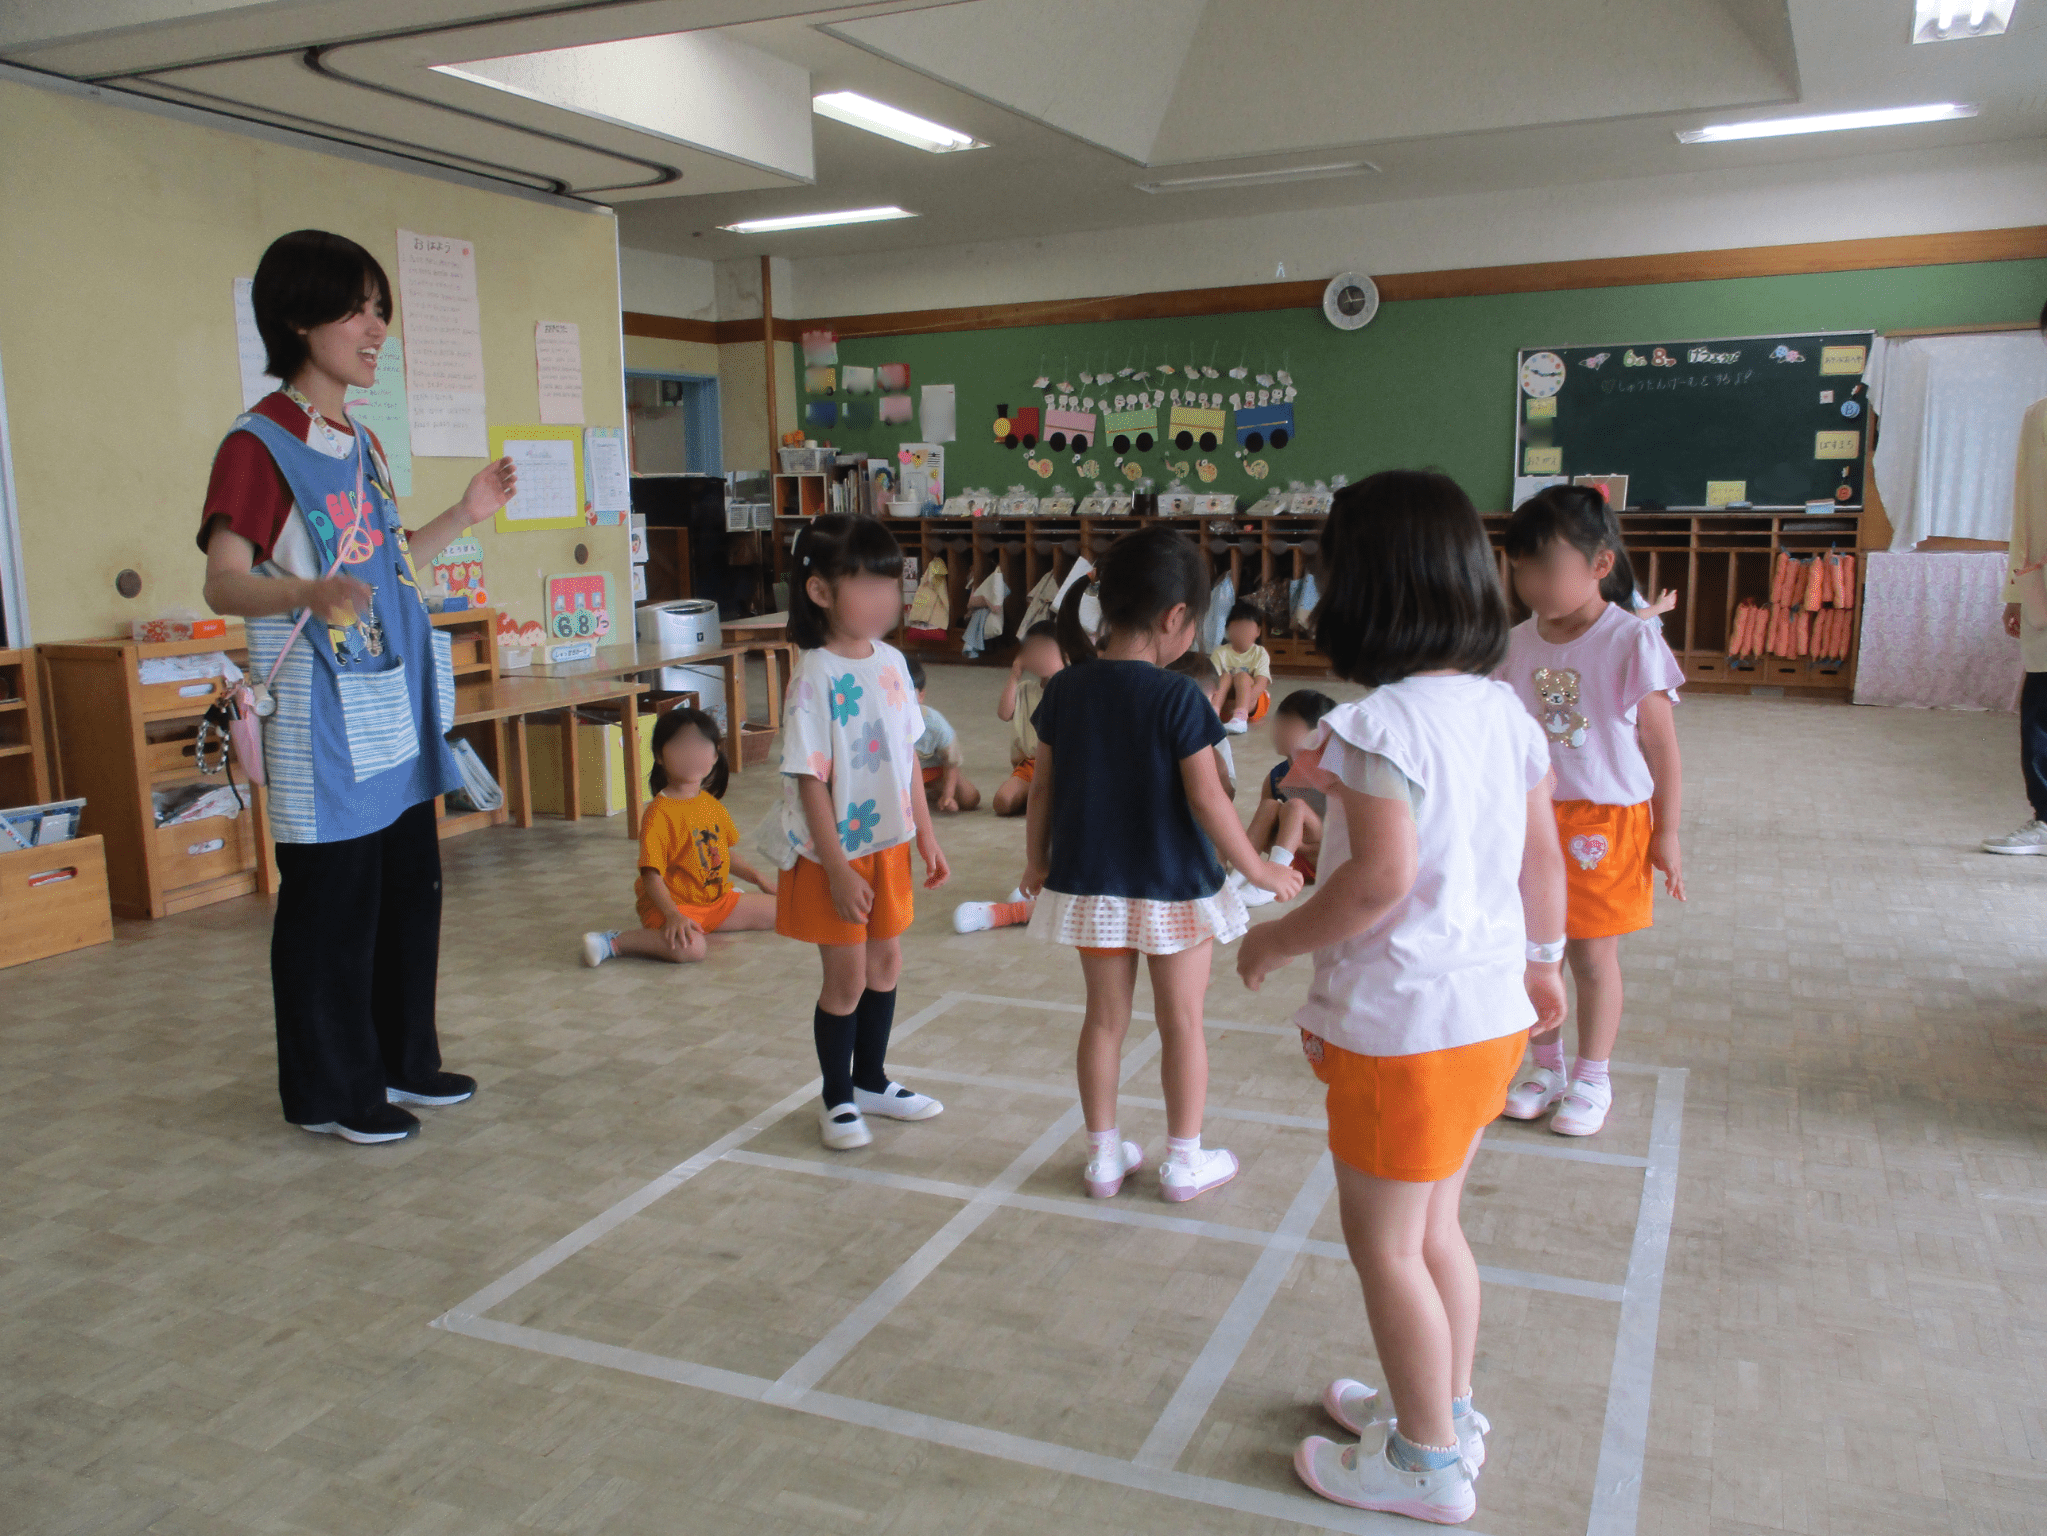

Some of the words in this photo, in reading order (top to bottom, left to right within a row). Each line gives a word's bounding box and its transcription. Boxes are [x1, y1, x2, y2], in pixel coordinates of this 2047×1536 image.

[414, 238, 451, 253] おはよう
[558, 616, 573, 638] 6
[579, 614, 590, 635] 8
